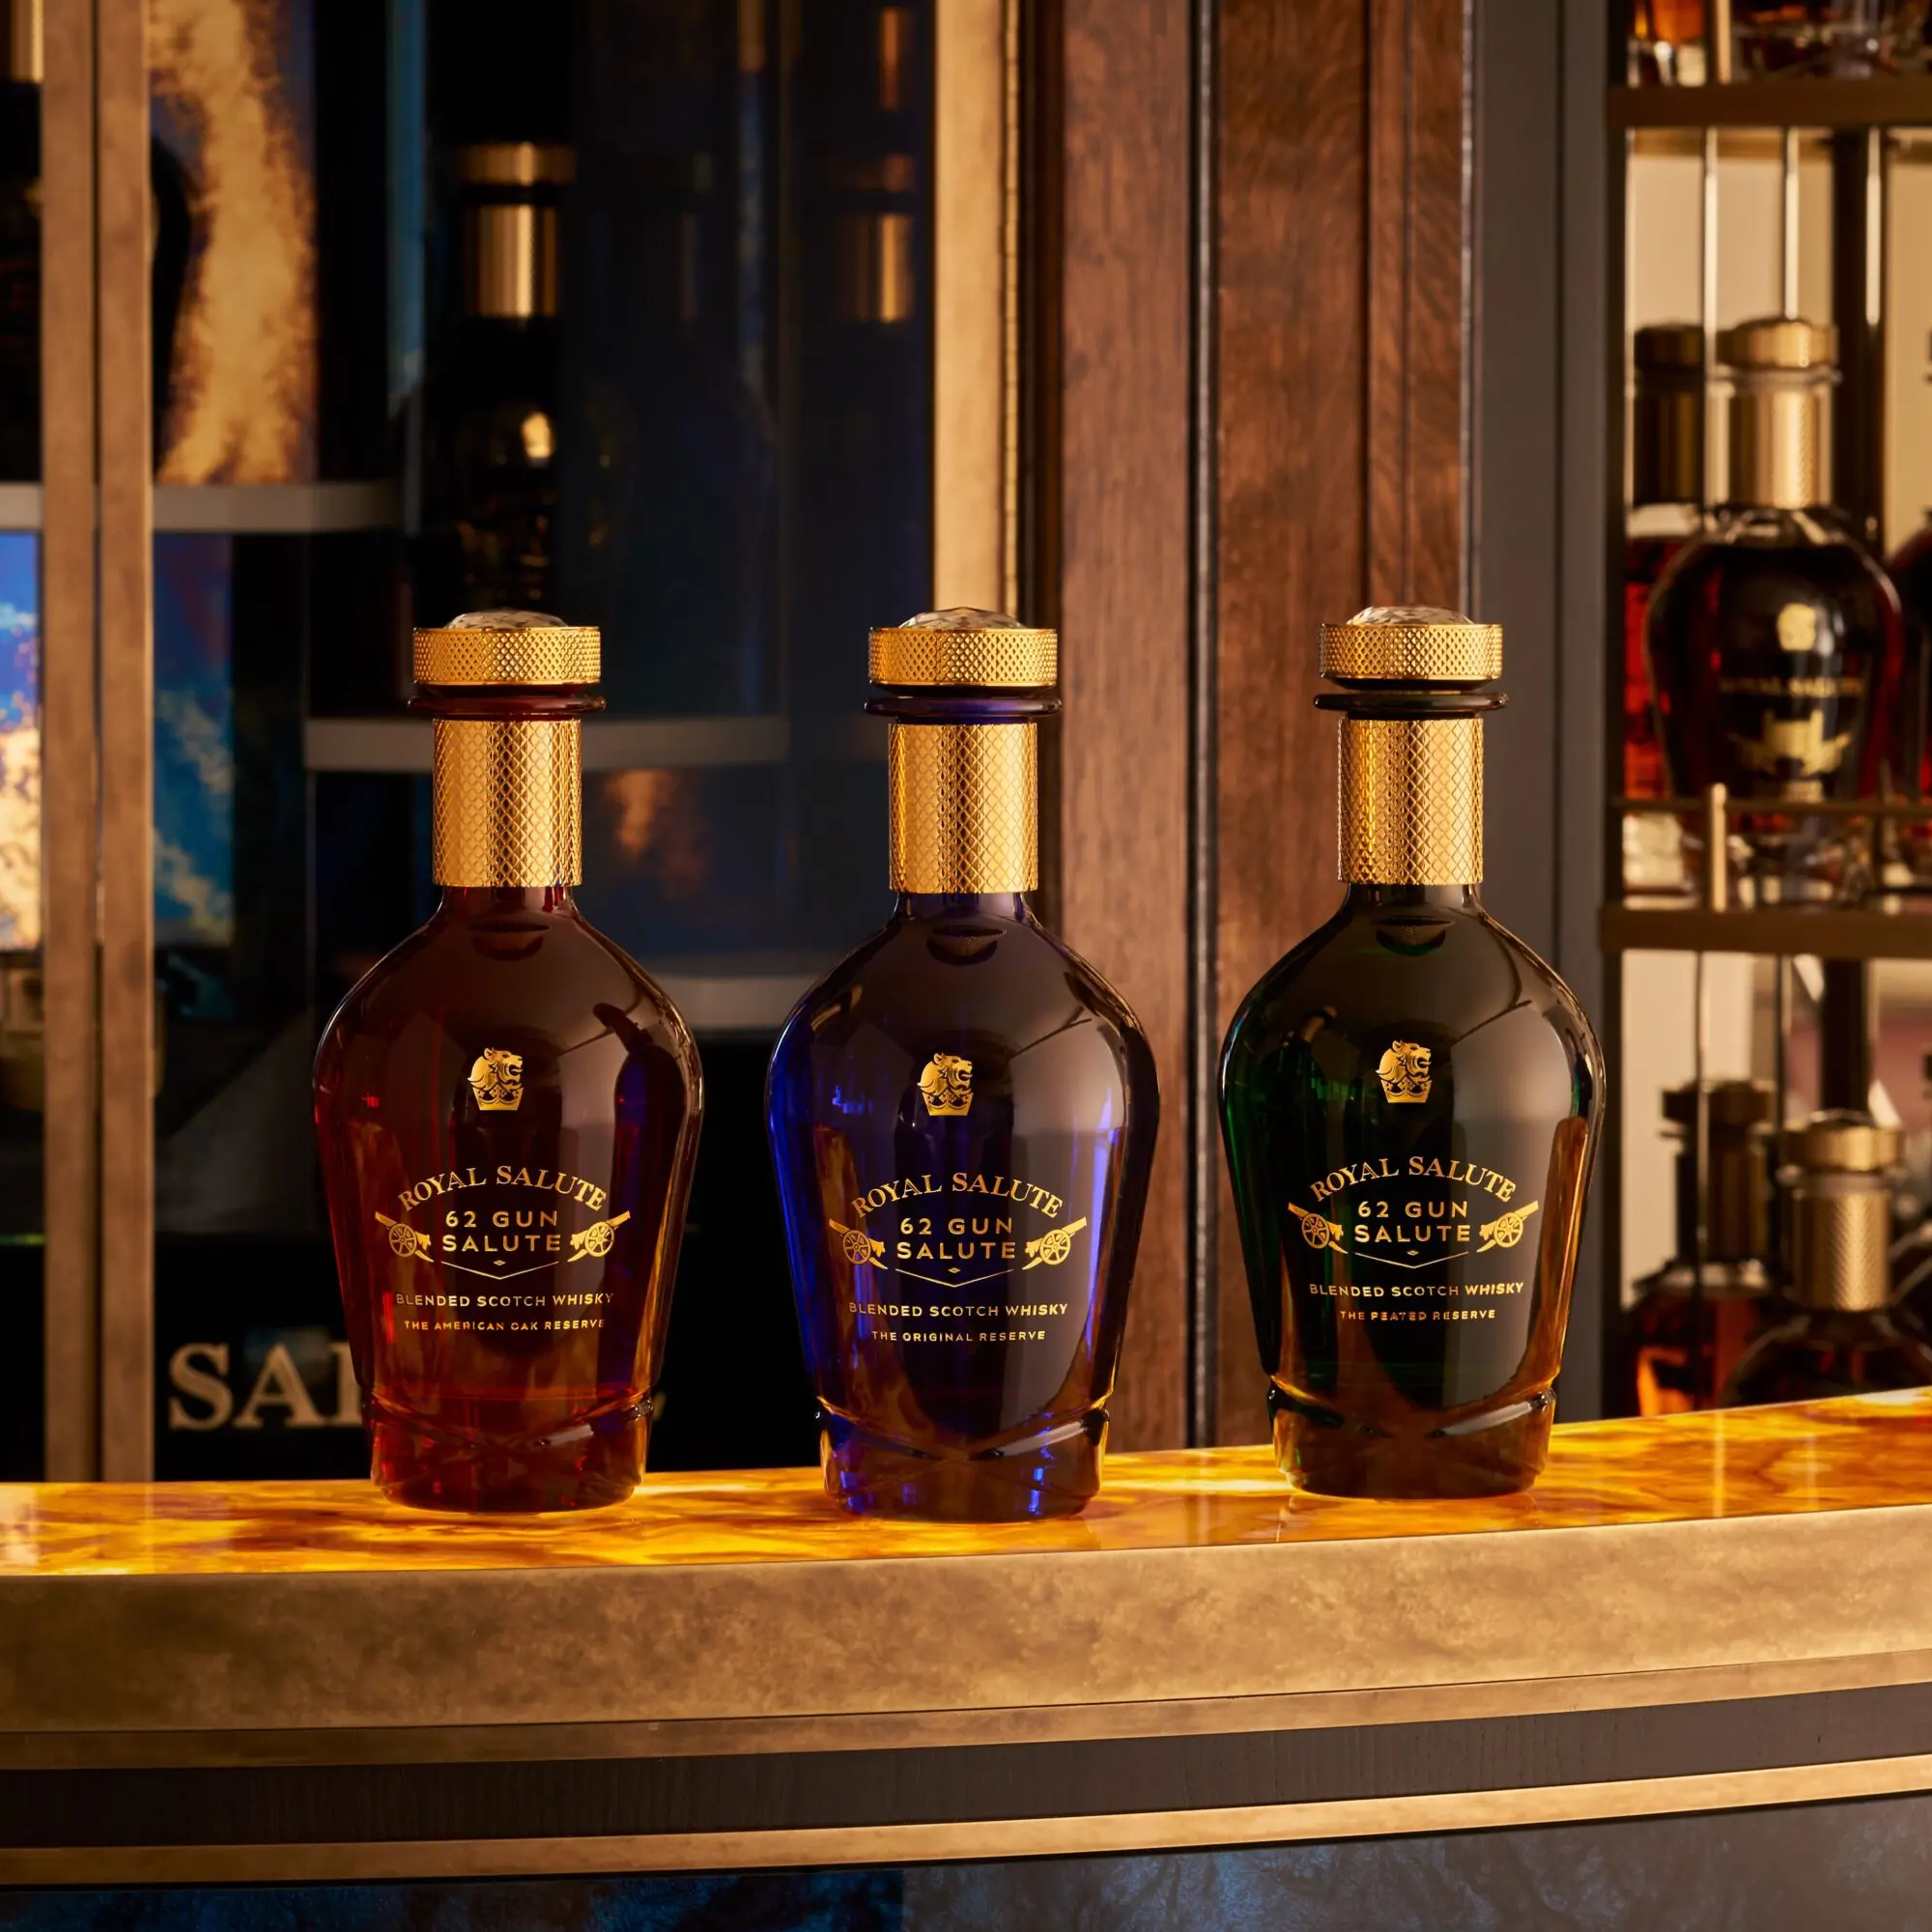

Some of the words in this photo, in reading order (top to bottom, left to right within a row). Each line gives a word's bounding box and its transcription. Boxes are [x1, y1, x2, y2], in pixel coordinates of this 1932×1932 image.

[397, 1167, 487, 1211] ROYAL
[496, 1165, 607, 1211] SALUTE
[1309, 1158, 1399, 1203] ROYAL
[1408, 1156, 1517, 1203] SALUTE
[851, 1174, 942, 1218] ROYAL
[952, 1172, 1064, 1218] SALUTE
[1357, 1201, 1389, 1218] 62
[1405, 1201, 1468, 1218] GUN
[445, 1210, 477, 1228] 62
[493, 1210, 557, 1227] GUN
[900, 1218, 932, 1236] 62
[948, 1218, 1012, 1235] GUN
[1354, 1225, 1470, 1242] SALUTE
[442, 1235, 560, 1252] SALUTE
[896, 1242, 1015, 1260] SALUTE
[1309, 1284, 1384, 1297] BLENDED
[1391, 1286, 1459, 1297] SCOTCH
[1464, 1282, 1523, 1295] WHISKY
[395, 1293, 470, 1306] BLENDED
[477, 1295, 546, 1307] SCOTCH
[553, 1293, 614, 1305] WHISKY
[848, 1302, 923, 1317] BLENDED
[929, 1306, 999, 1317] SCOTCH
[1006, 1303, 1068, 1317] WHISKY
[1340, 1310, 1365, 1321] THE
[1371, 1312, 1427, 1321] PEATED
[1433, 1310, 1496, 1321] RESERVE
[404, 1320, 428, 1330] THE
[435, 1321, 504, 1330] AMERICAN
[511, 1321, 538, 1330] OAK
[544, 1320, 605, 1329] RESERVE
[871, 1330, 896, 1341] THE
[902, 1332, 973, 1342] ORIGINAL
[979, 1330, 1045, 1342] RESERVE
